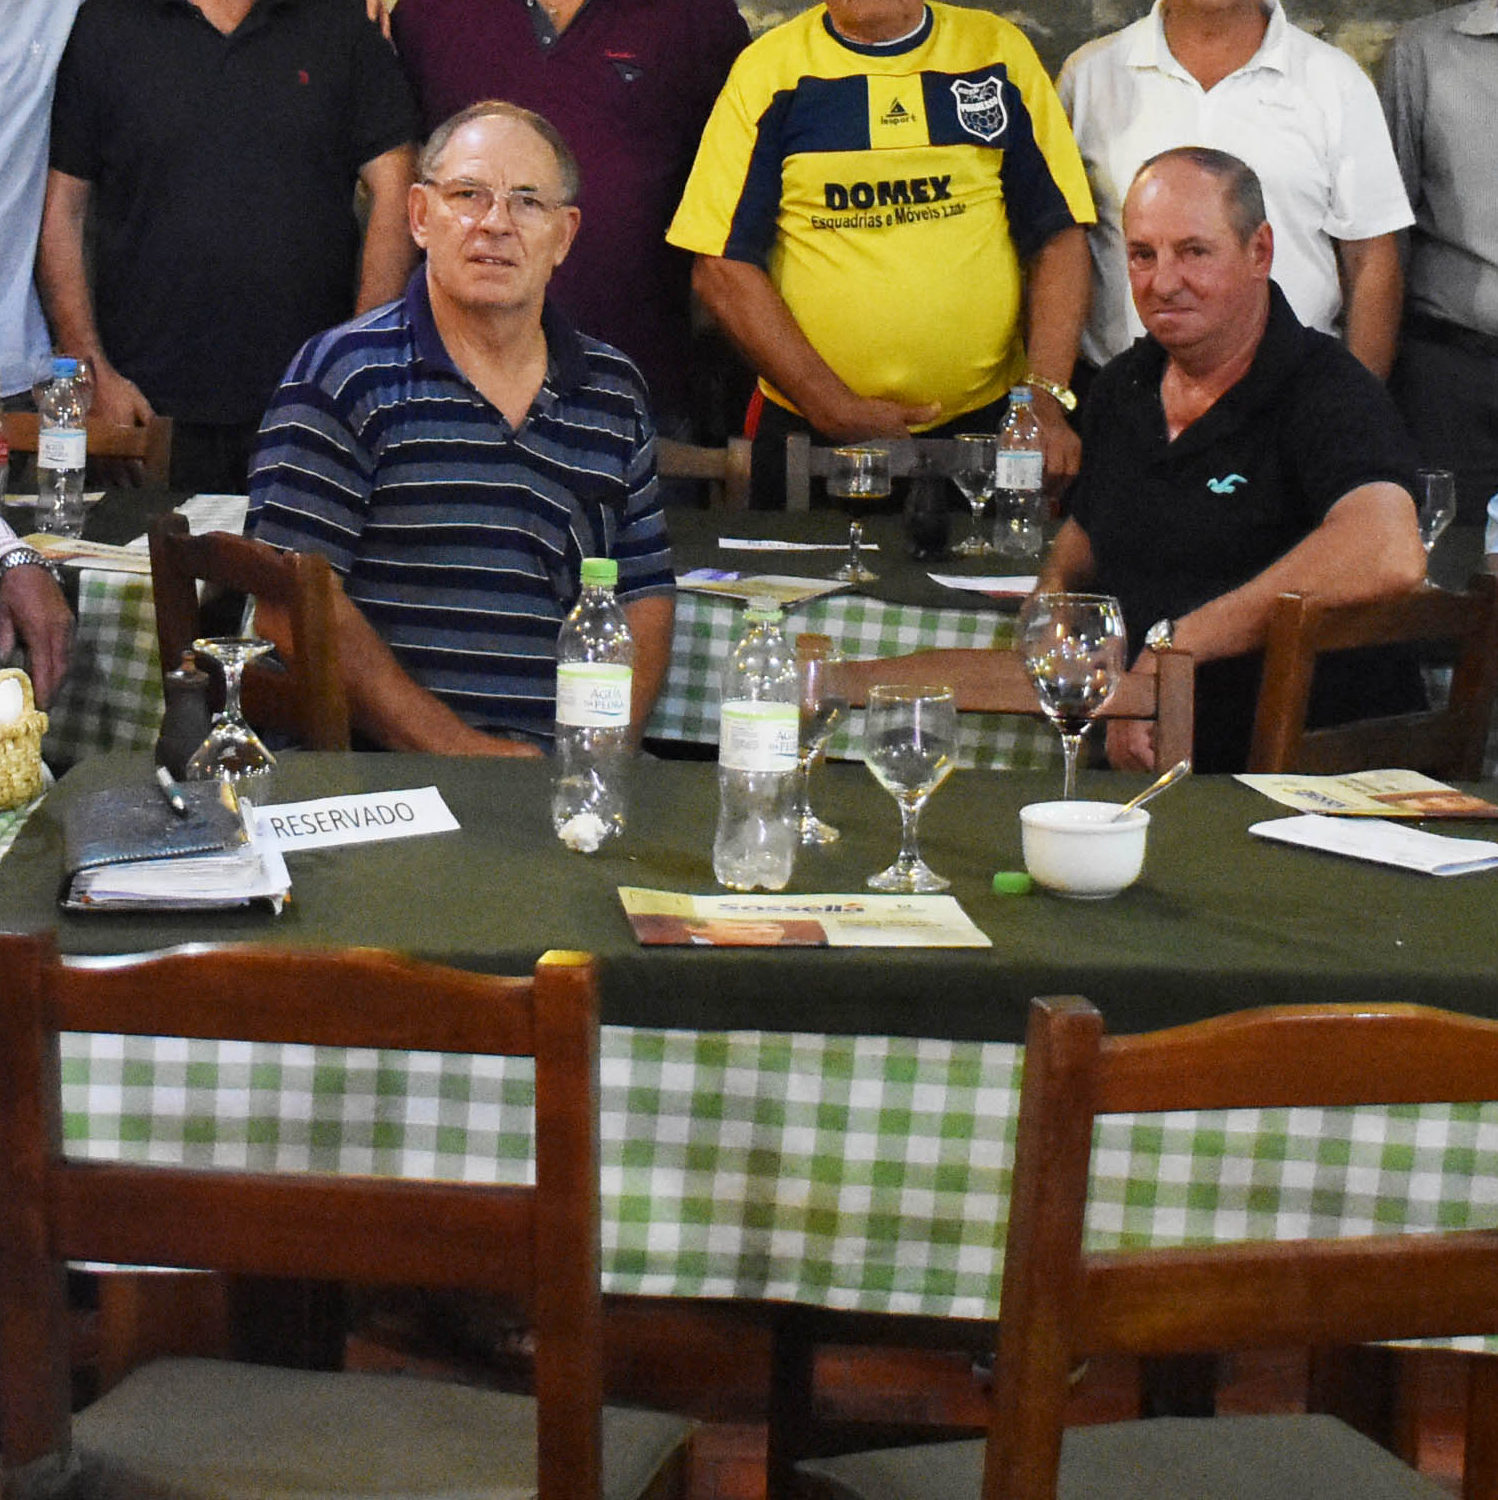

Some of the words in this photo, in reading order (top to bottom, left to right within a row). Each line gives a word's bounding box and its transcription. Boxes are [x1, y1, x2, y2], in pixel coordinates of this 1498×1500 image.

[824, 175, 953, 211] DOMEX
[812, 212, 883, 230] Esquadrias
[885, 214, 893, 227] e
[895, 206, 940, 225] Móveis
[270, 802, 415, 839] RESERVADO
